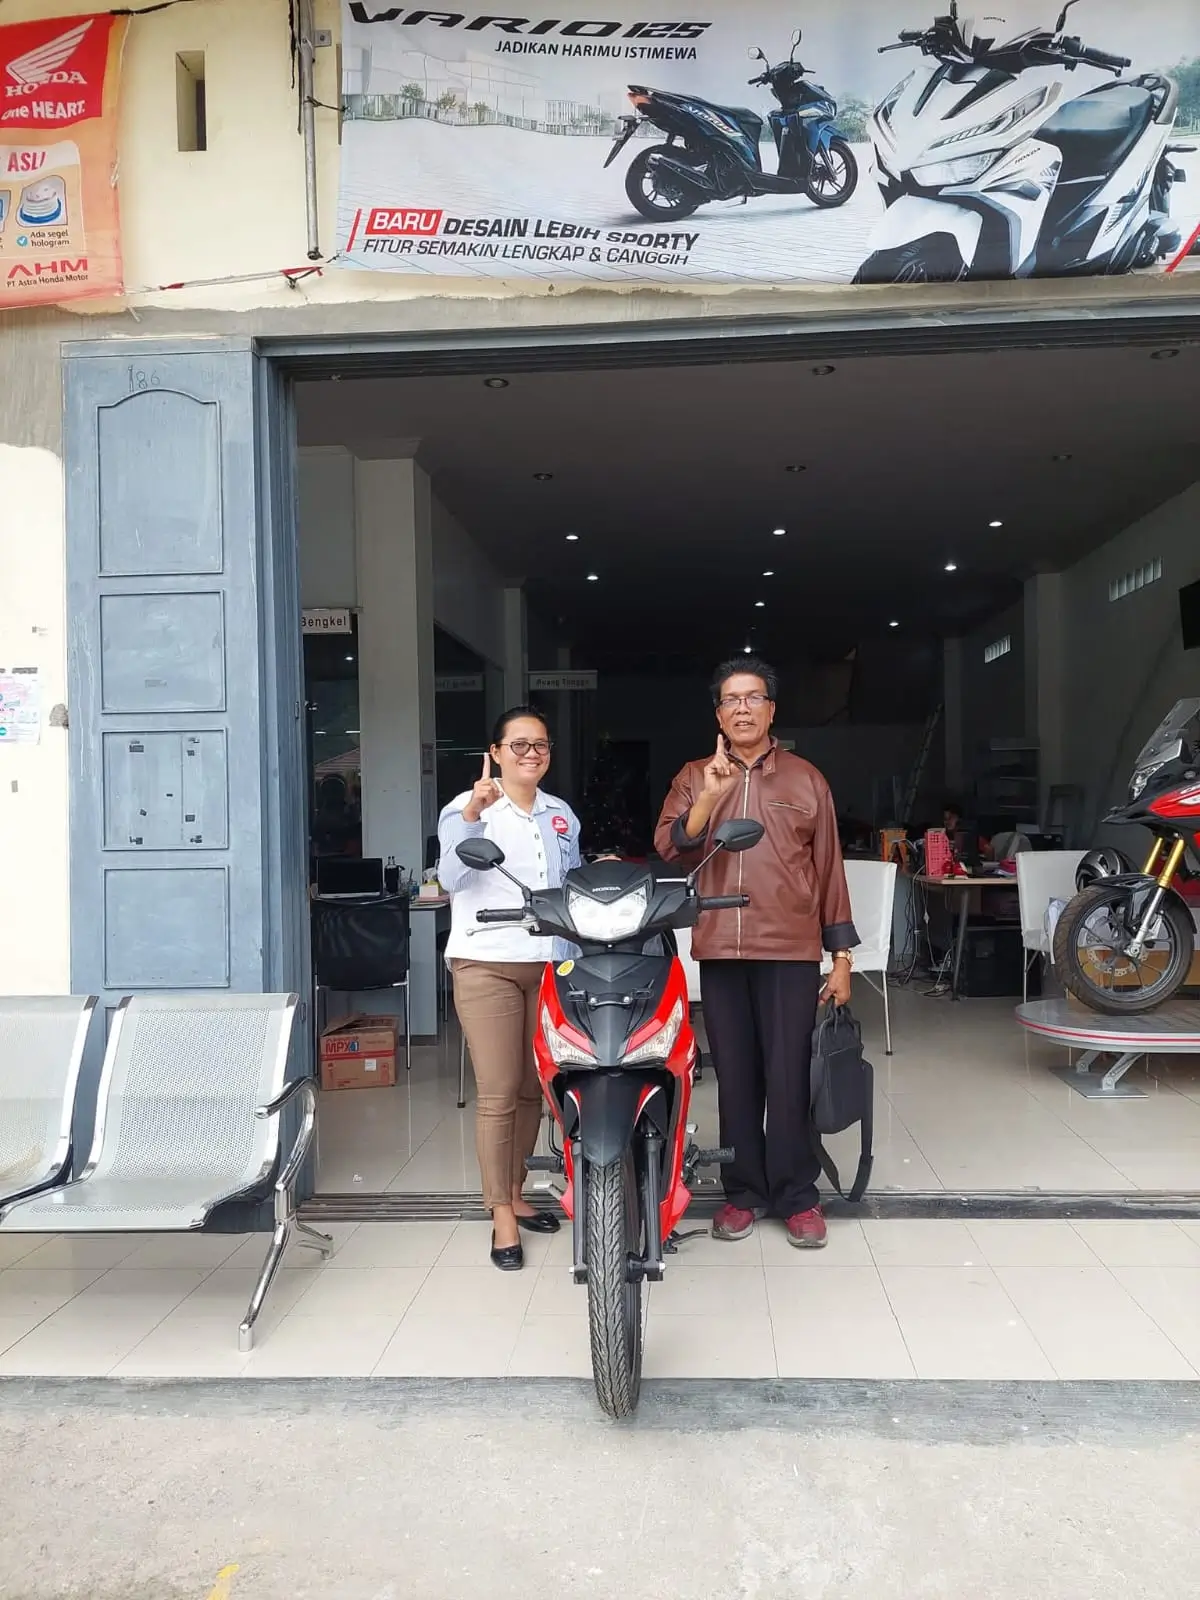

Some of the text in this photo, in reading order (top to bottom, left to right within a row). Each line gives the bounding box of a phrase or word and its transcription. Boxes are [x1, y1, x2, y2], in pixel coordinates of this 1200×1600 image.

[348, 2, 712, 39] VARIO 125
[495, 40, 697, 60] JADIKAN HARIMU ISTIMEWA
[5, 71, 88, 97] HODA
[30, 229, 69, 239] Ada segel
[372, 211, 700, 251] BARU DESAIN LEBIH SPORTY
[30, 239, 70, 248] hologram
[363, 239, 690, 266] FITUR SEMAKIN LENGKAP & CANGGIH
[8, 258, 89, 279] AHM
[18, 279, 37, 287] Astra
[39, 275, 65, 284] Honda
[66, 274, 89, 282] Motor
